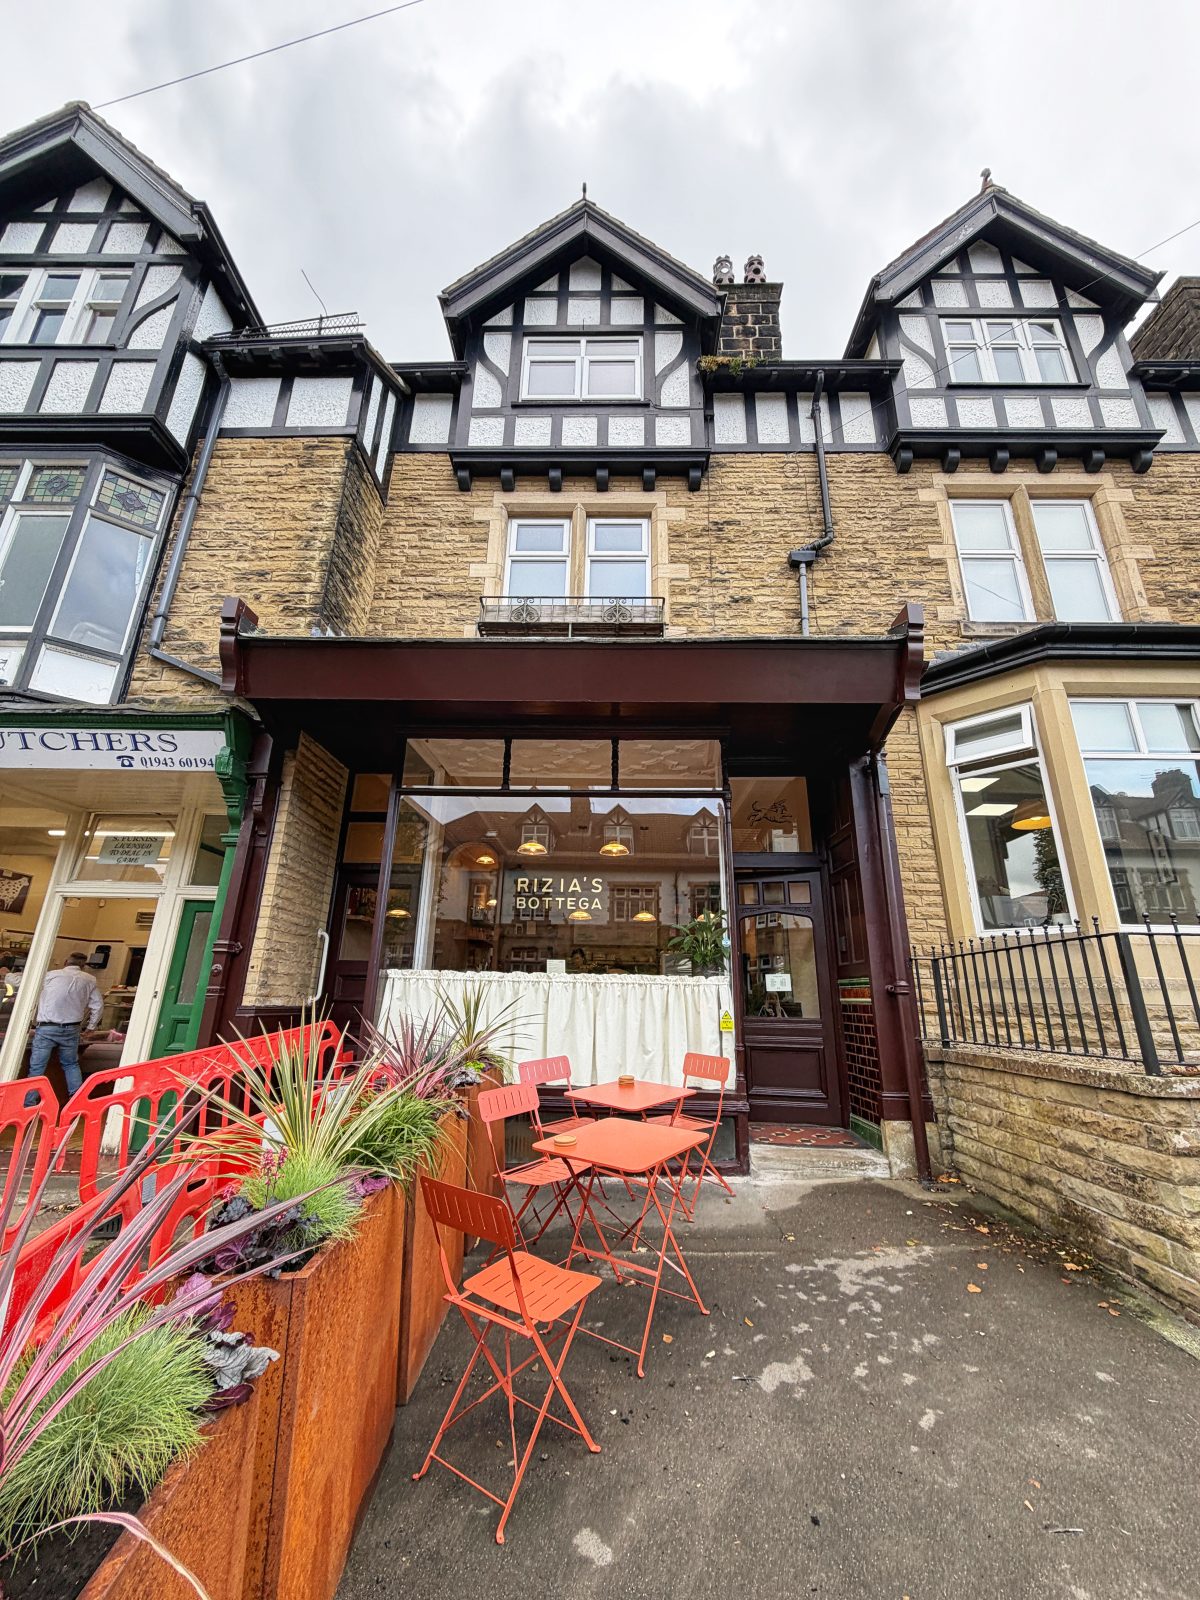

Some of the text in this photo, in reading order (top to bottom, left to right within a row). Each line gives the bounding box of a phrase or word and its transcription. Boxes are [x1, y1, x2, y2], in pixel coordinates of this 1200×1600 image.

[140, 756, 175, 768] 01943
[517, 876, 603, 893] RIZIA'S
[516, 897, 602, 910] BOTTEGA
